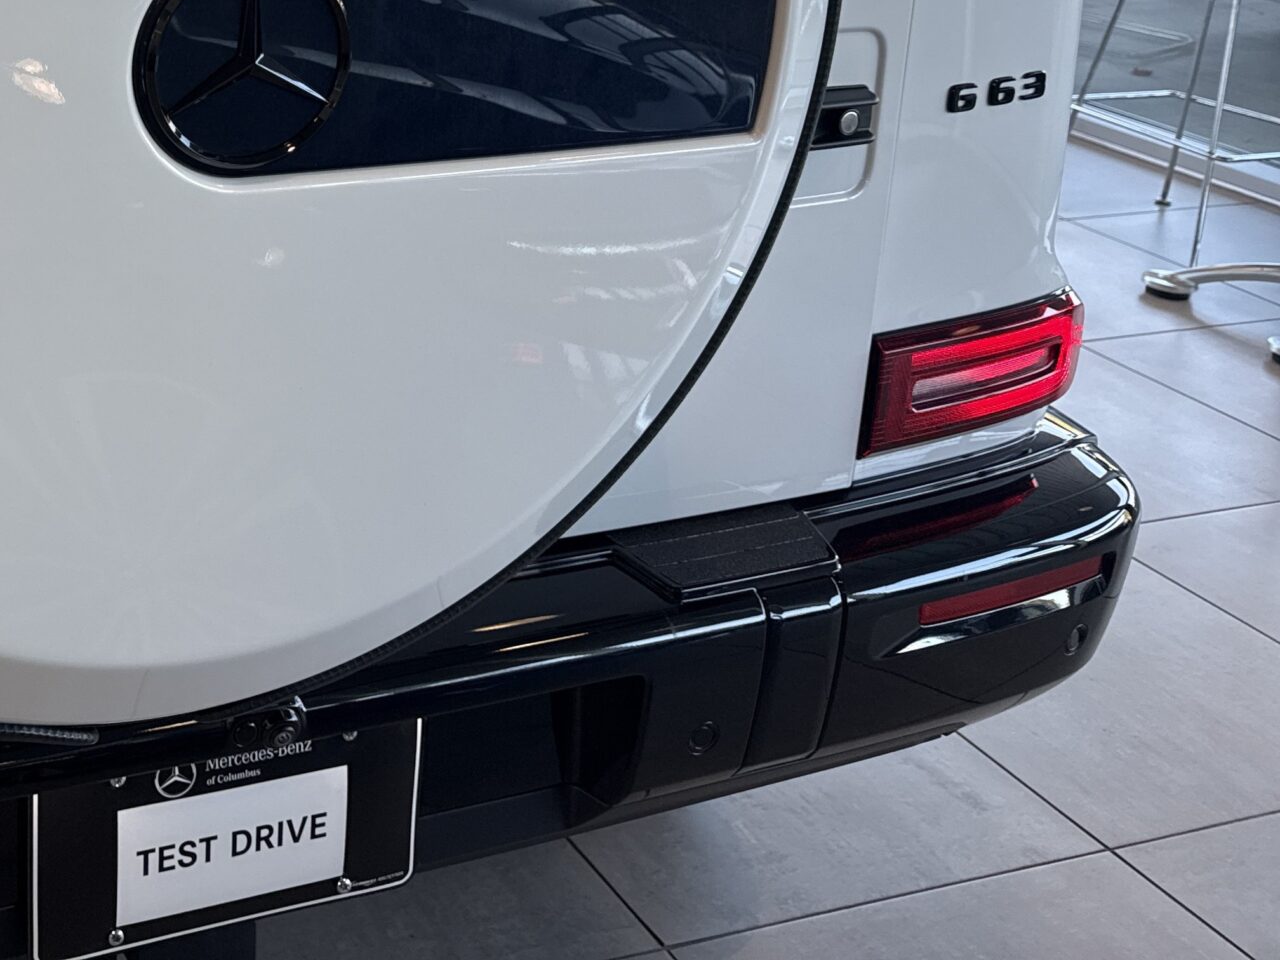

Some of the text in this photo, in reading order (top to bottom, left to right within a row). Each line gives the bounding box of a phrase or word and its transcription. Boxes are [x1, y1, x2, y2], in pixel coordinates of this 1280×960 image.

[945, 70, 1047, 113] G 63
[206, 768, 261, 786] of Columbus
[136, 812, 328, 876] TEST DRIVE
